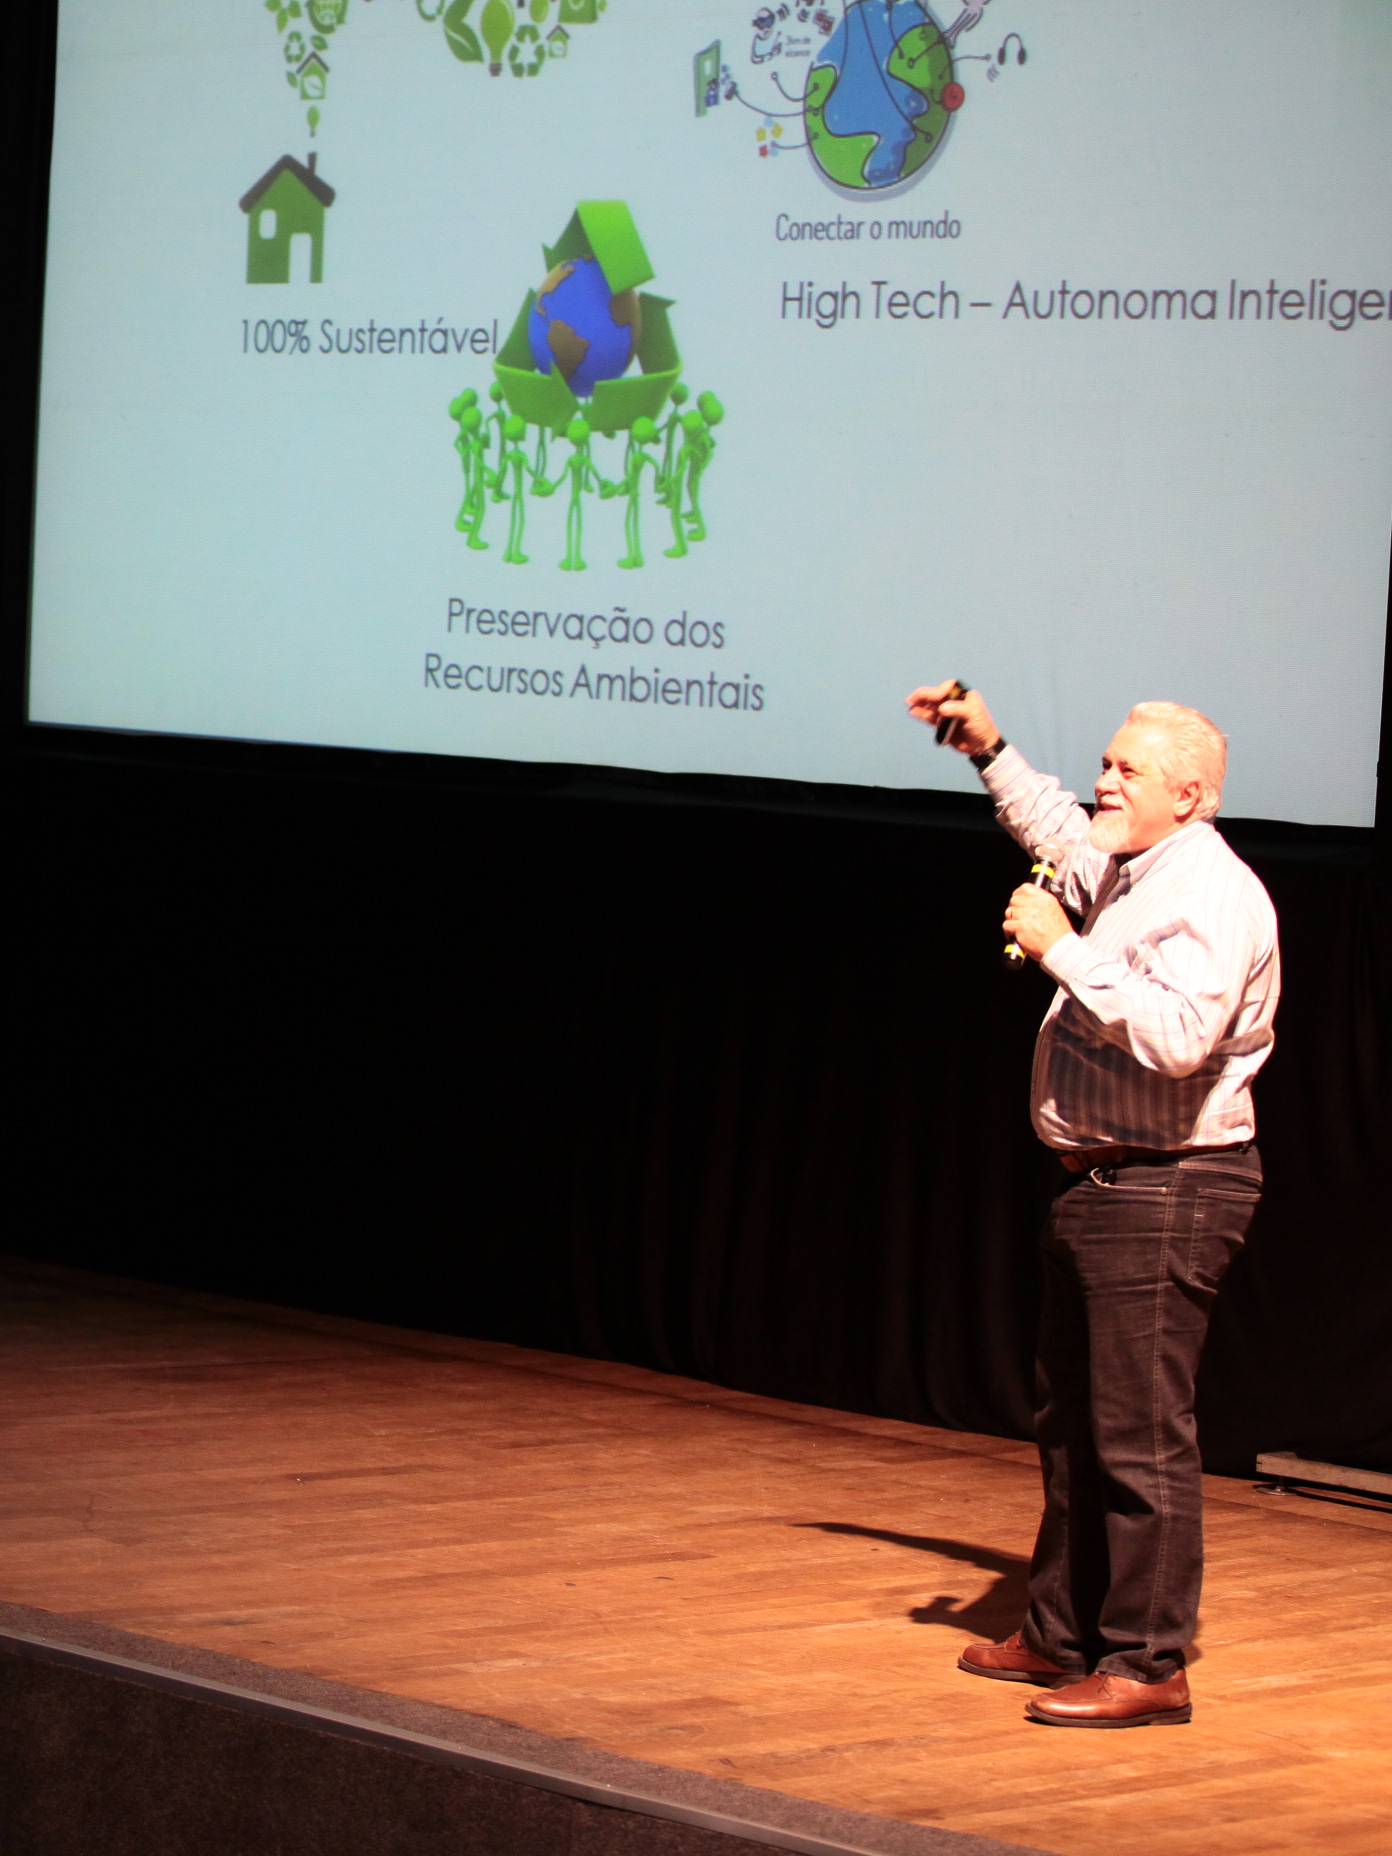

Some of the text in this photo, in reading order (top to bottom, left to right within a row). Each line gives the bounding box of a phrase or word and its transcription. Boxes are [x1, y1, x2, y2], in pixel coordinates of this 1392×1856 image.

[776, 210, 961, 241] Conectar o mundo
[782, 281, 860, 329] High
[871, 281, 960, 319] Tech
[1002, 280, 1217, 320] Autonoma
[1229, 279, 1392, 331] Intelige
[241, 317, 498, 355] 100% Sustentável
[448, 598, 724, 649] Preservação dos
[425, 653, 764, 711] Recursos Ambientais
